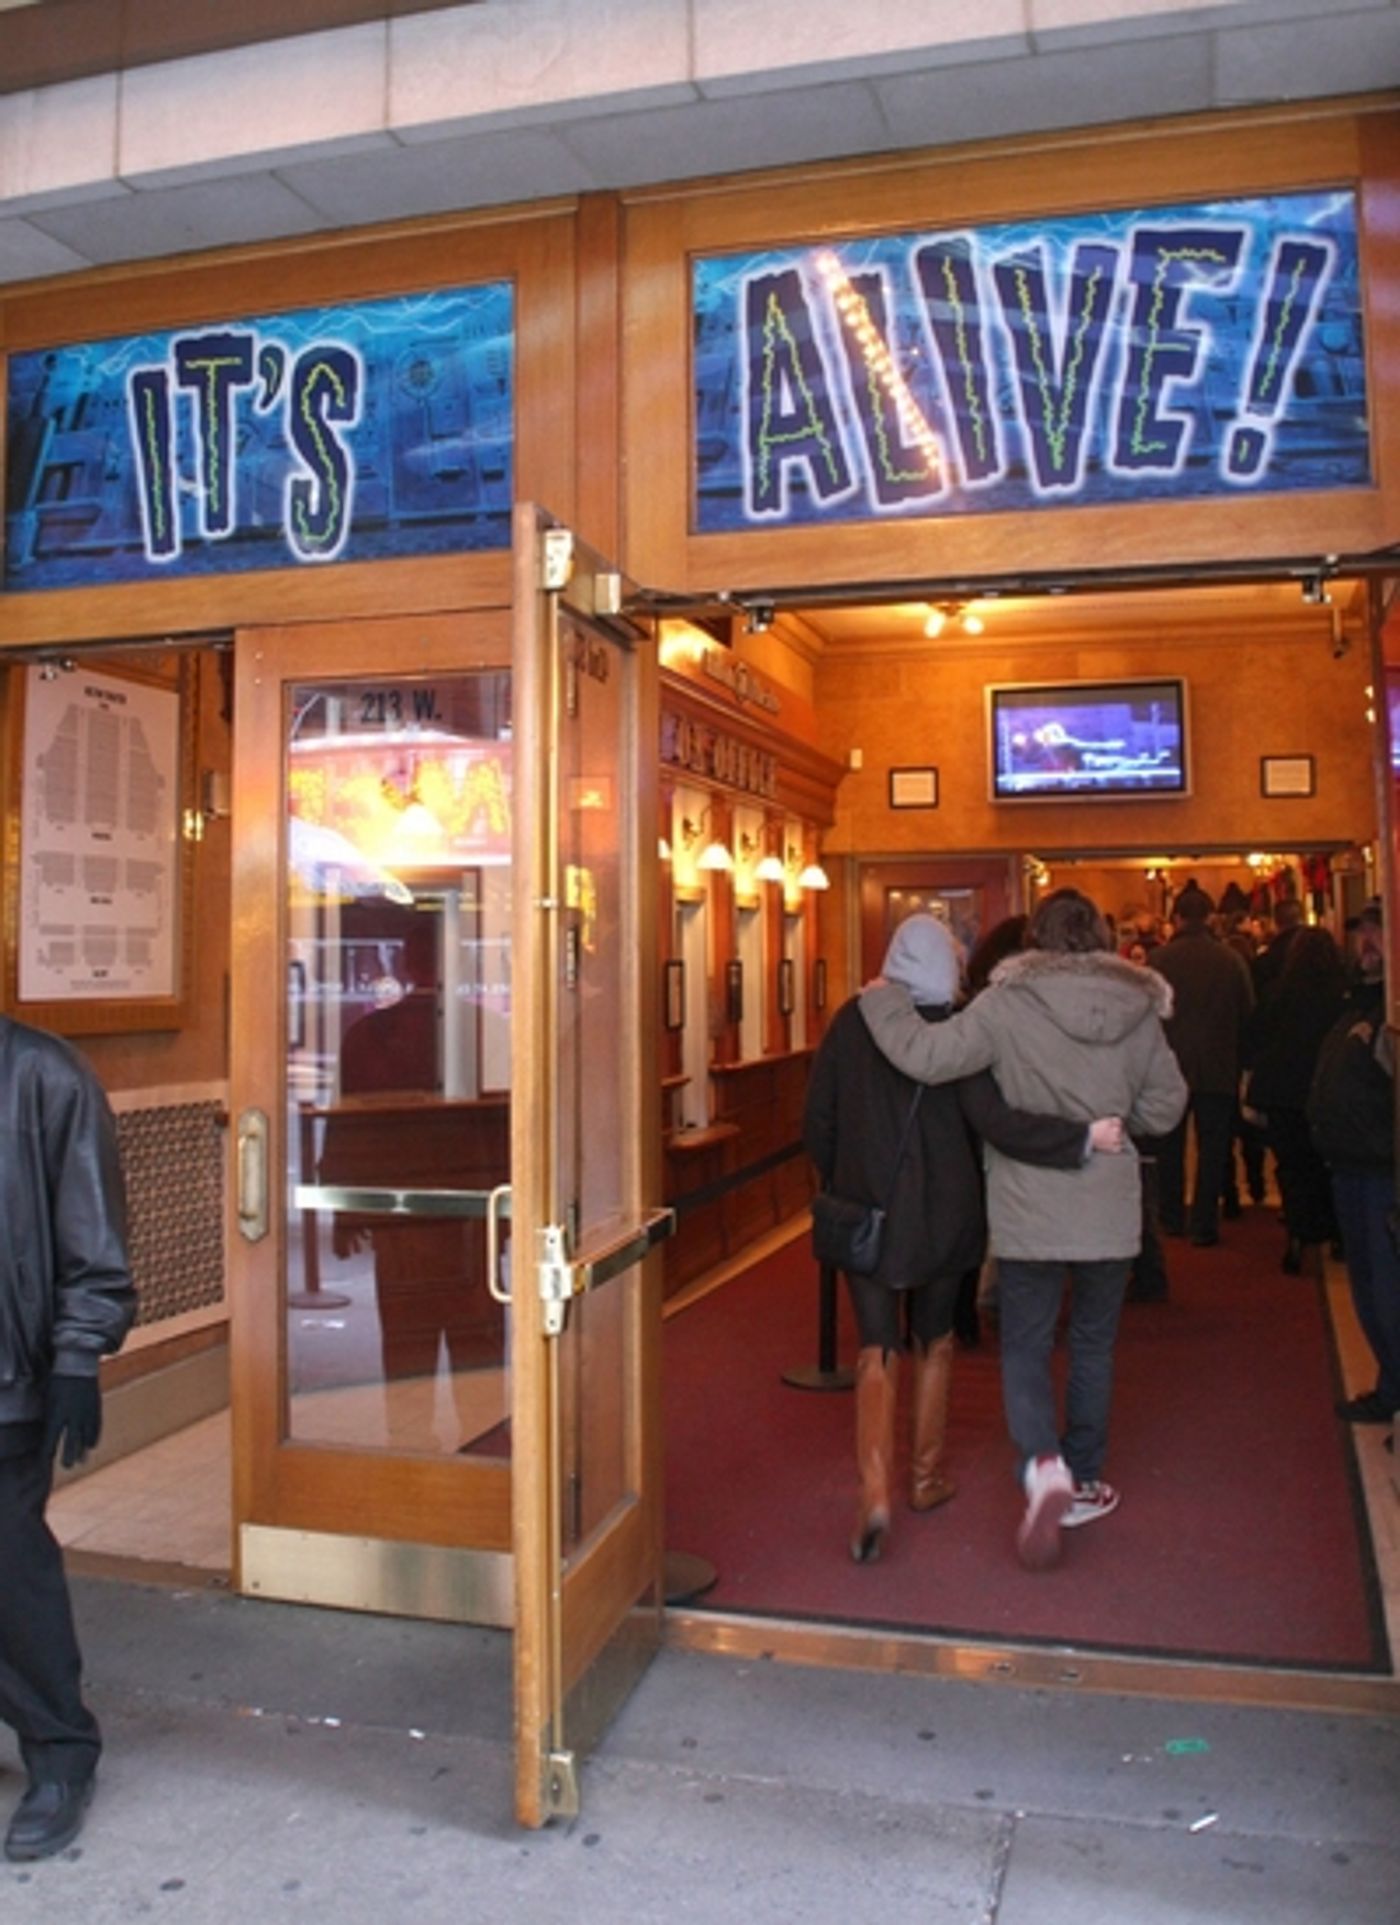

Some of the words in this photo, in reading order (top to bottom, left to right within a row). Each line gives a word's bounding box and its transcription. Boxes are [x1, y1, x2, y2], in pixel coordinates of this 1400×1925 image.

[130, 328, 362, 562] IT'S
[741, 222, 1335, 519] ALIVE!
[360, 690, 402, 723] 213
[412, 689, 443, 721] W.
